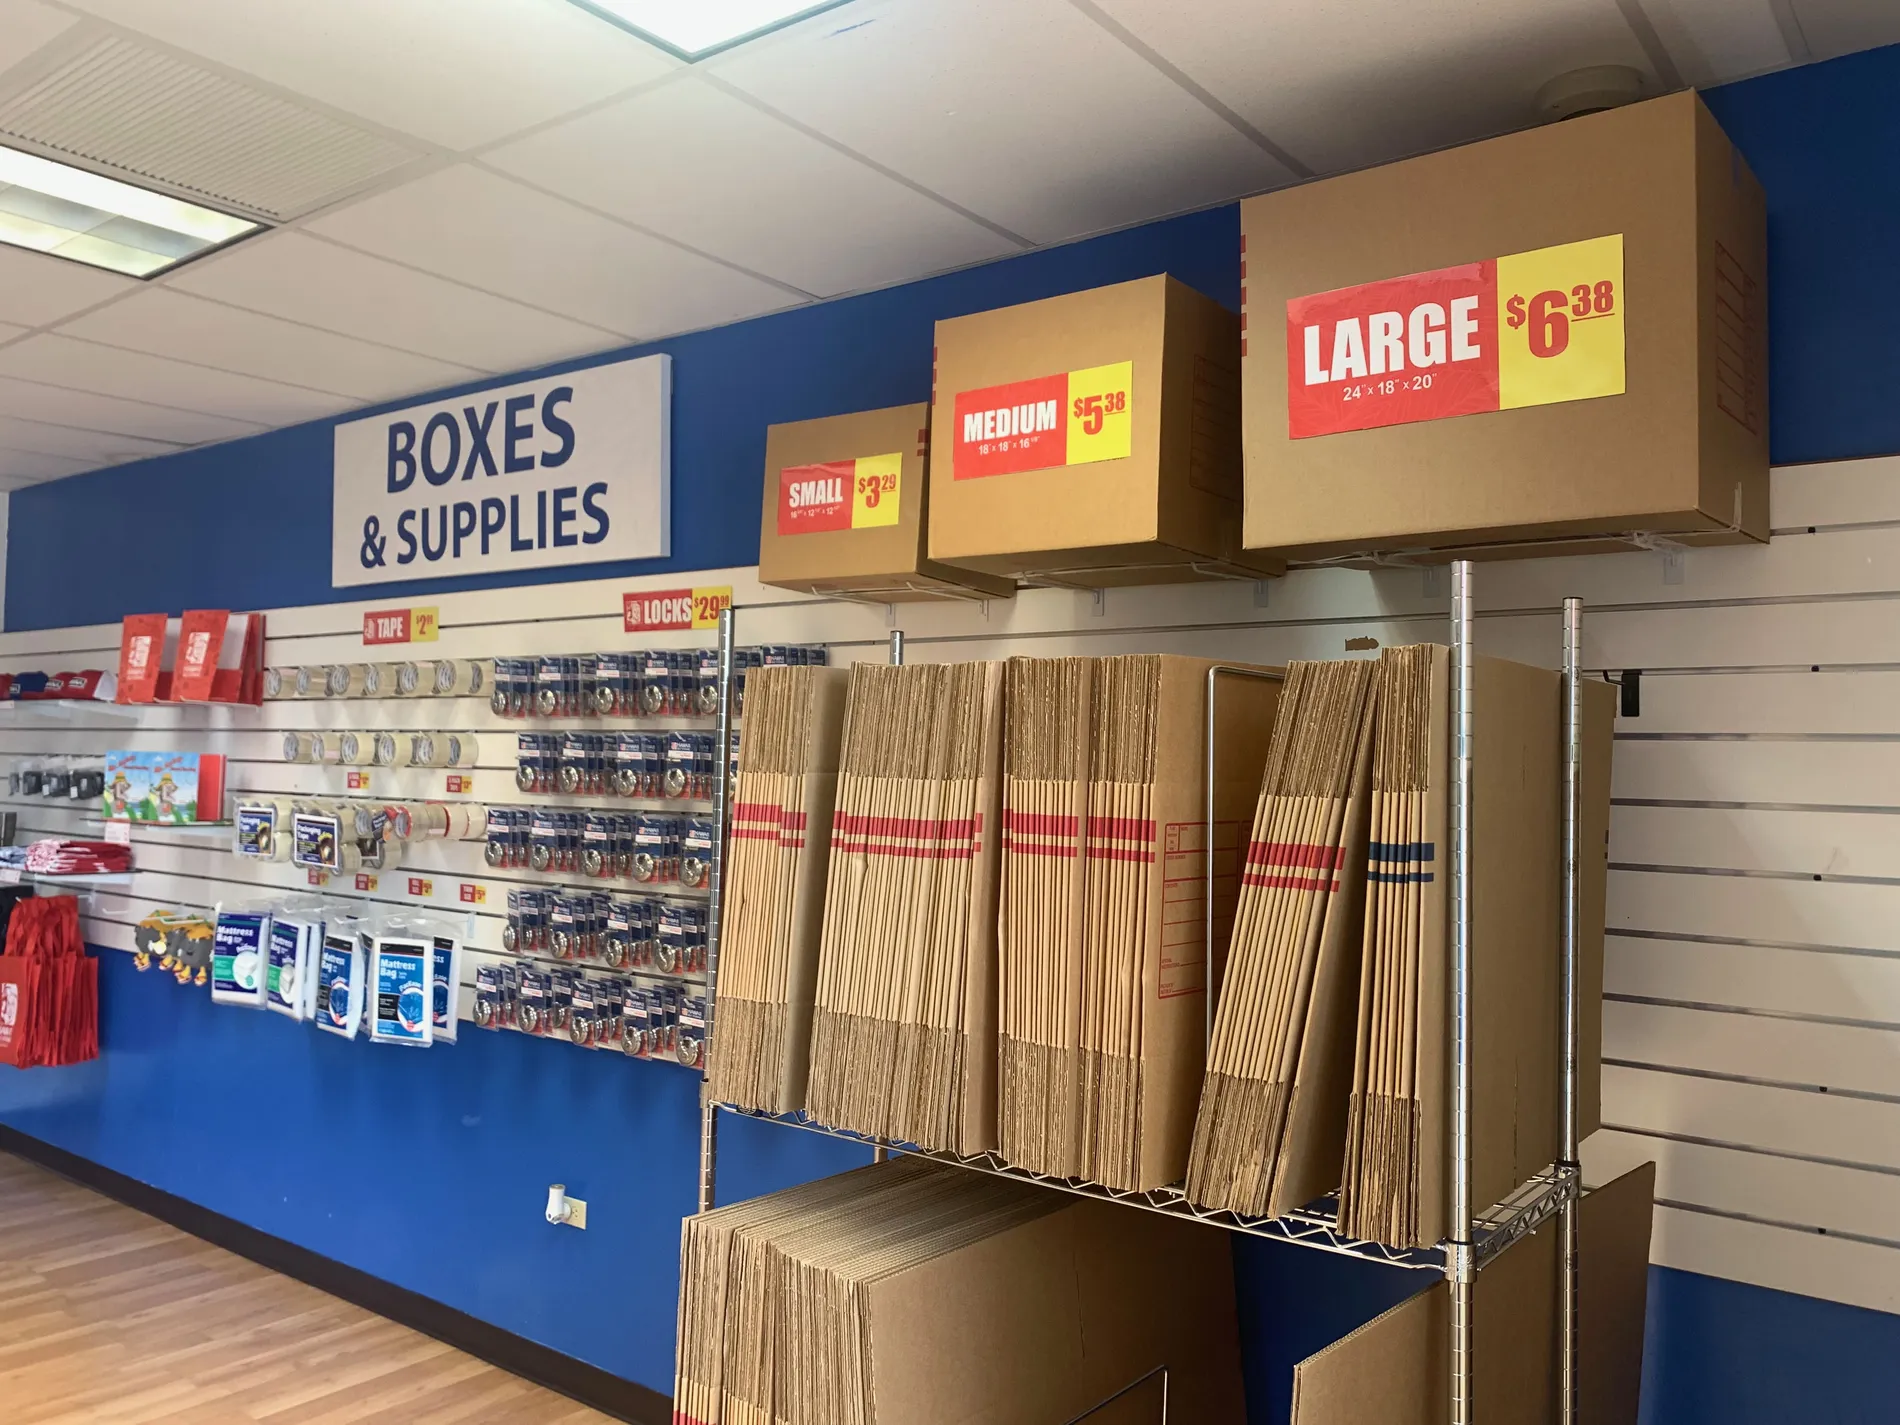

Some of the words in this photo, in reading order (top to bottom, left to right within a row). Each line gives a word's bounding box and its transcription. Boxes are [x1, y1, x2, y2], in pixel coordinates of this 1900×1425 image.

[1303, 295, 1481, 387] LARGE
[963, 399, 1057, 443] MEDIUM
[386, 386, 576, 494] BOXES
[789, 477, 844, 508] SMALL
[359, 514, 387, 569] &
[396, 481, 611, 565] SUPPLIES
[643, 596, 692, 625] LOCKS
[377, 616, 404, 639] TAPE
[216, 933, 233, 945] Bag
[217, 925, 254, 937] Mattress
[380, 958, 416, 971] Mattress
[380, 967, 397, 980] Bag
